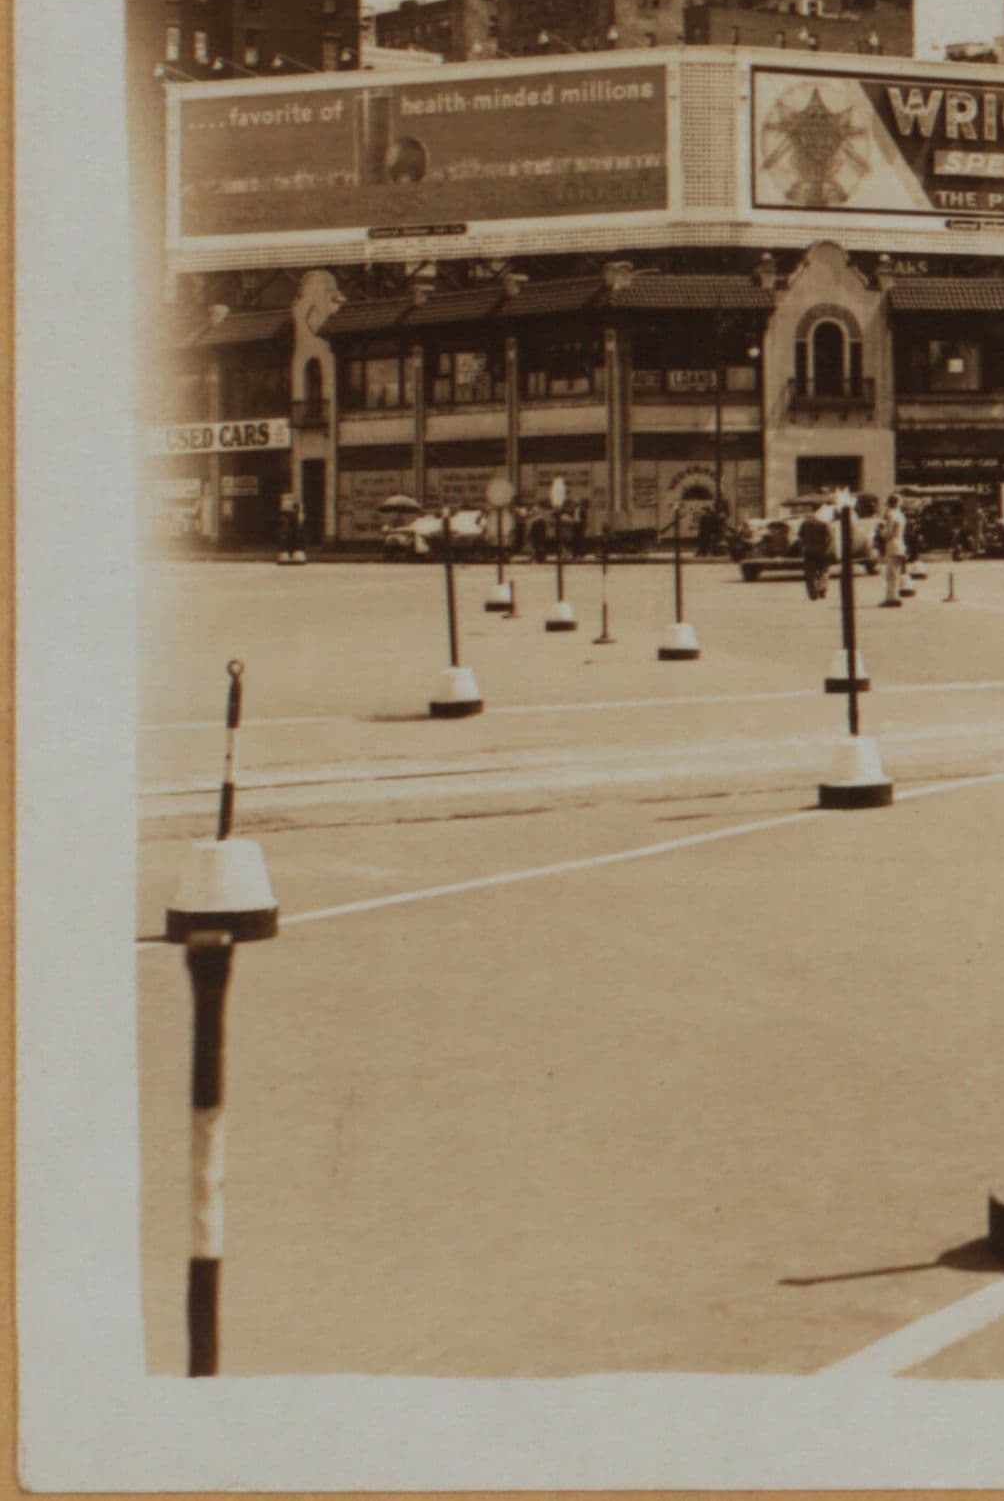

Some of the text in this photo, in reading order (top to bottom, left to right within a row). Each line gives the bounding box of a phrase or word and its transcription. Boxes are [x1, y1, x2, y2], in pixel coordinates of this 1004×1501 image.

[320, 99, 345, 121] of
[560, 79, 654, 104] millions
[936, 189, 977, 208] THE
[165, 427, 214, 450] USED
[219, 422, 270, 447] CARS
